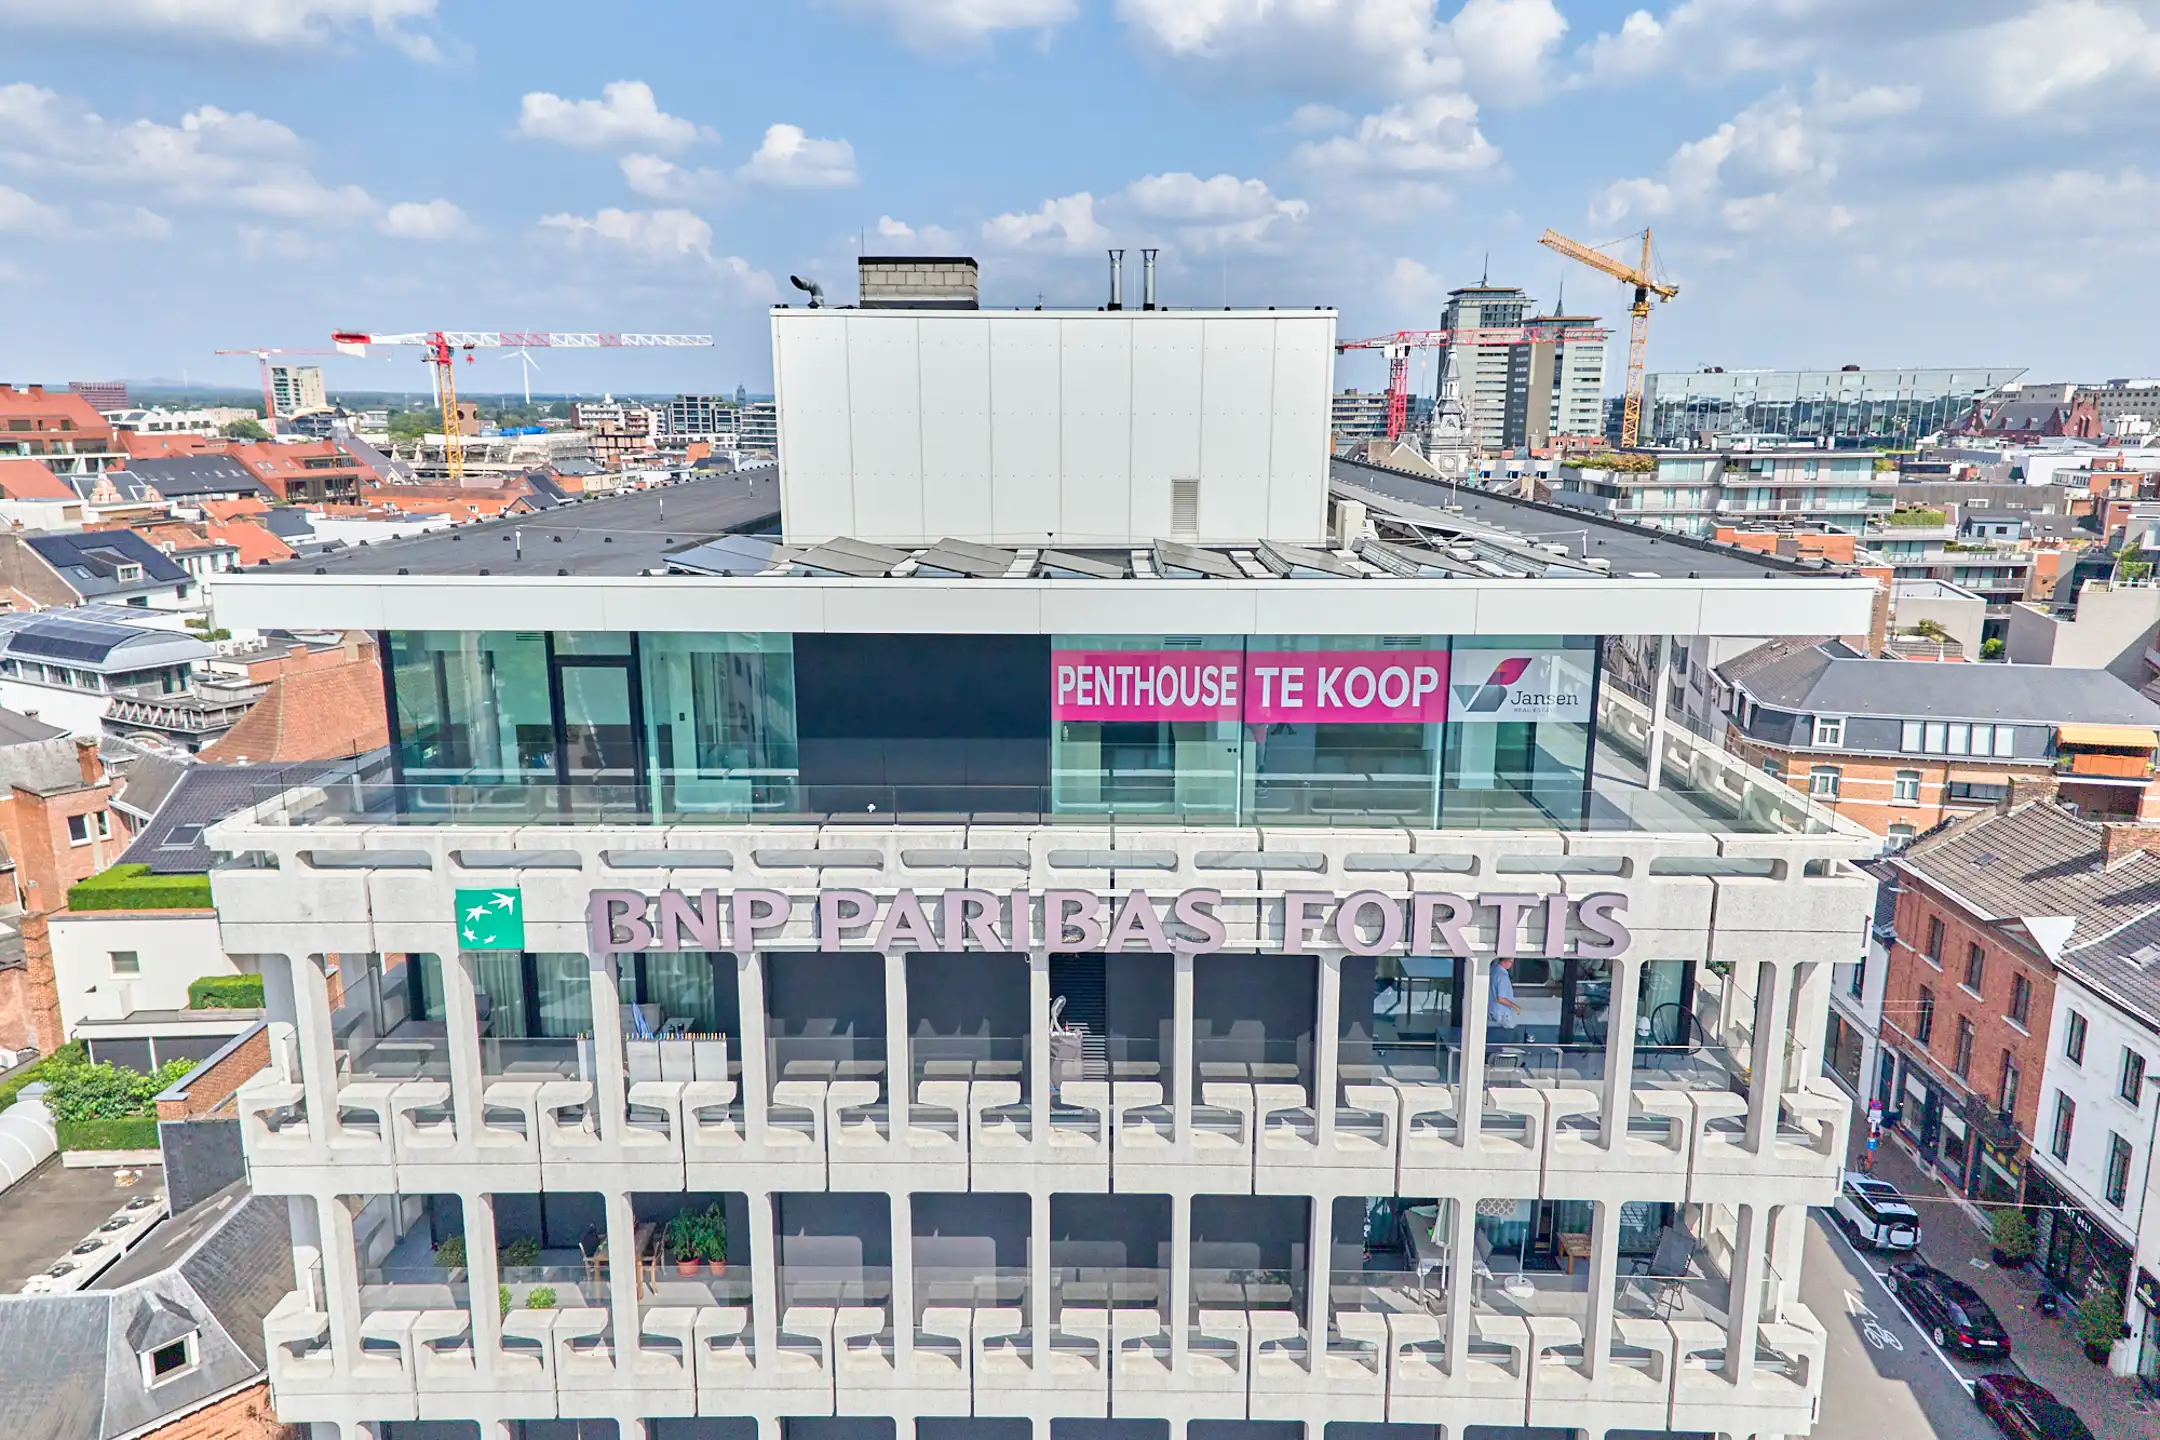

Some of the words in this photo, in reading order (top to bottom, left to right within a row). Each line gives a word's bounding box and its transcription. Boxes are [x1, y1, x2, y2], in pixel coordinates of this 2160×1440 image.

[1058, 665, 1238, 707] PENTHOUSE
[1255, 667, 1304, 708] TE
[1317, 666, 1439, 708] KOOP
[1511, 690, 1579, 706] Jansen
[590, 888, 790, 953] BNP
[818, 888, 1227, 955] PARIBAS
[1282, 889, 1632, 958] FORTIS
